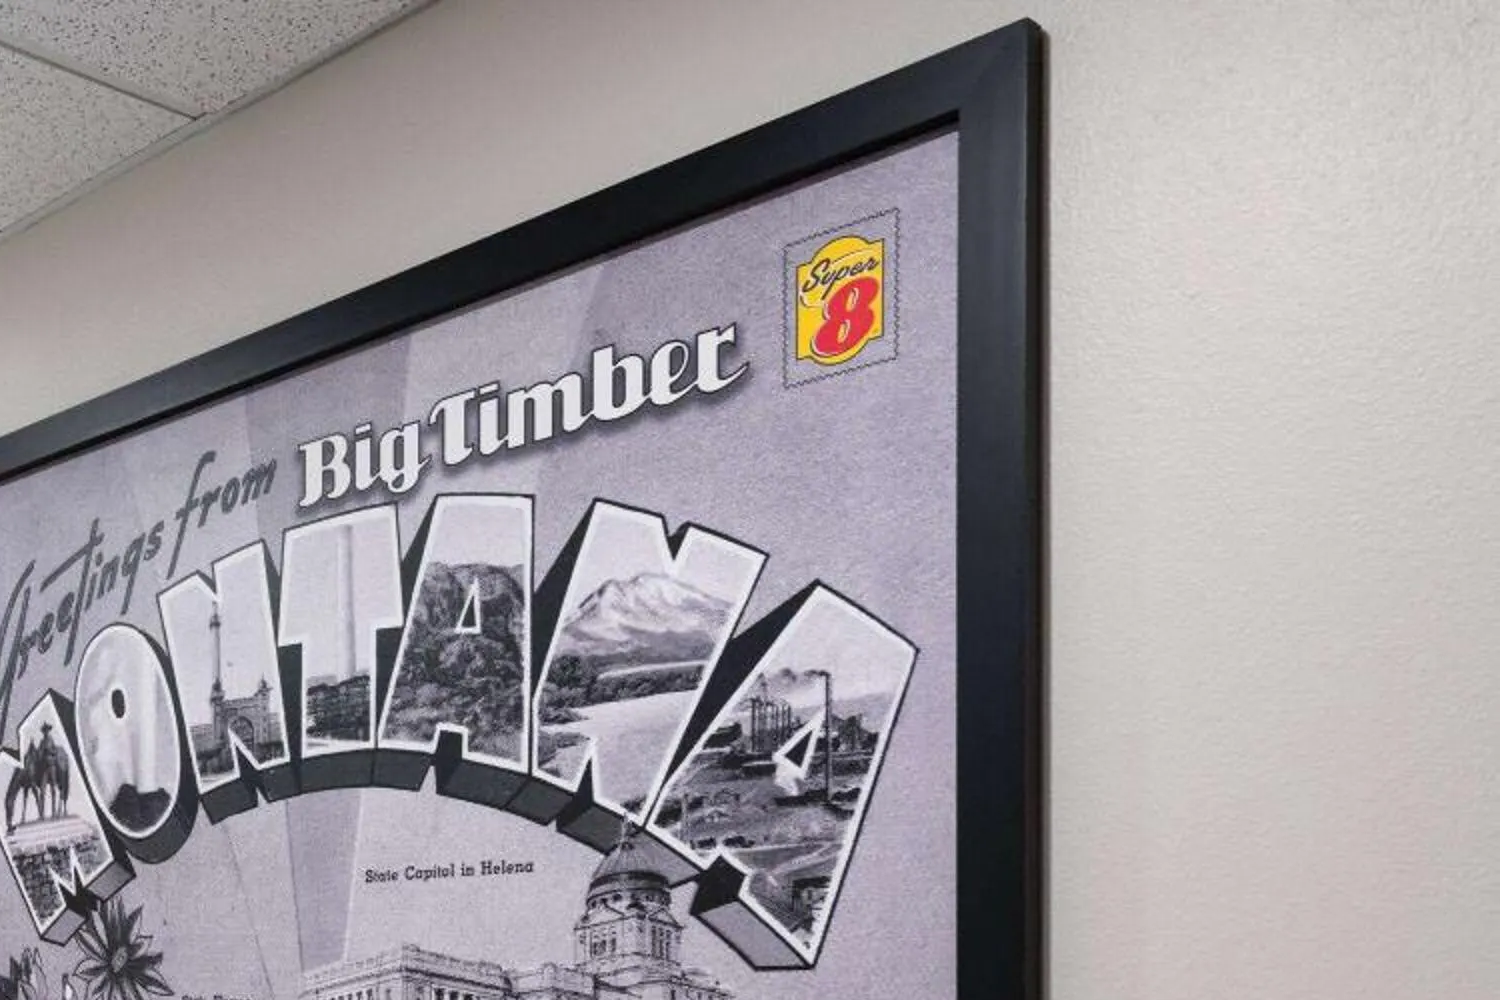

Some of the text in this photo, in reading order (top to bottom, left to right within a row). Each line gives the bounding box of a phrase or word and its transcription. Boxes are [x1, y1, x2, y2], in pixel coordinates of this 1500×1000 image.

[802, 257, 879, 300] Super
[808, 276, 881, 357] 8
[299, 321, 749, 508] Big Timber
[165, 450, 278, 580] from
[365, 869, 398, 883] State
[461, 861, 475, 877] in
[480, 860, 534, 876] Helena
